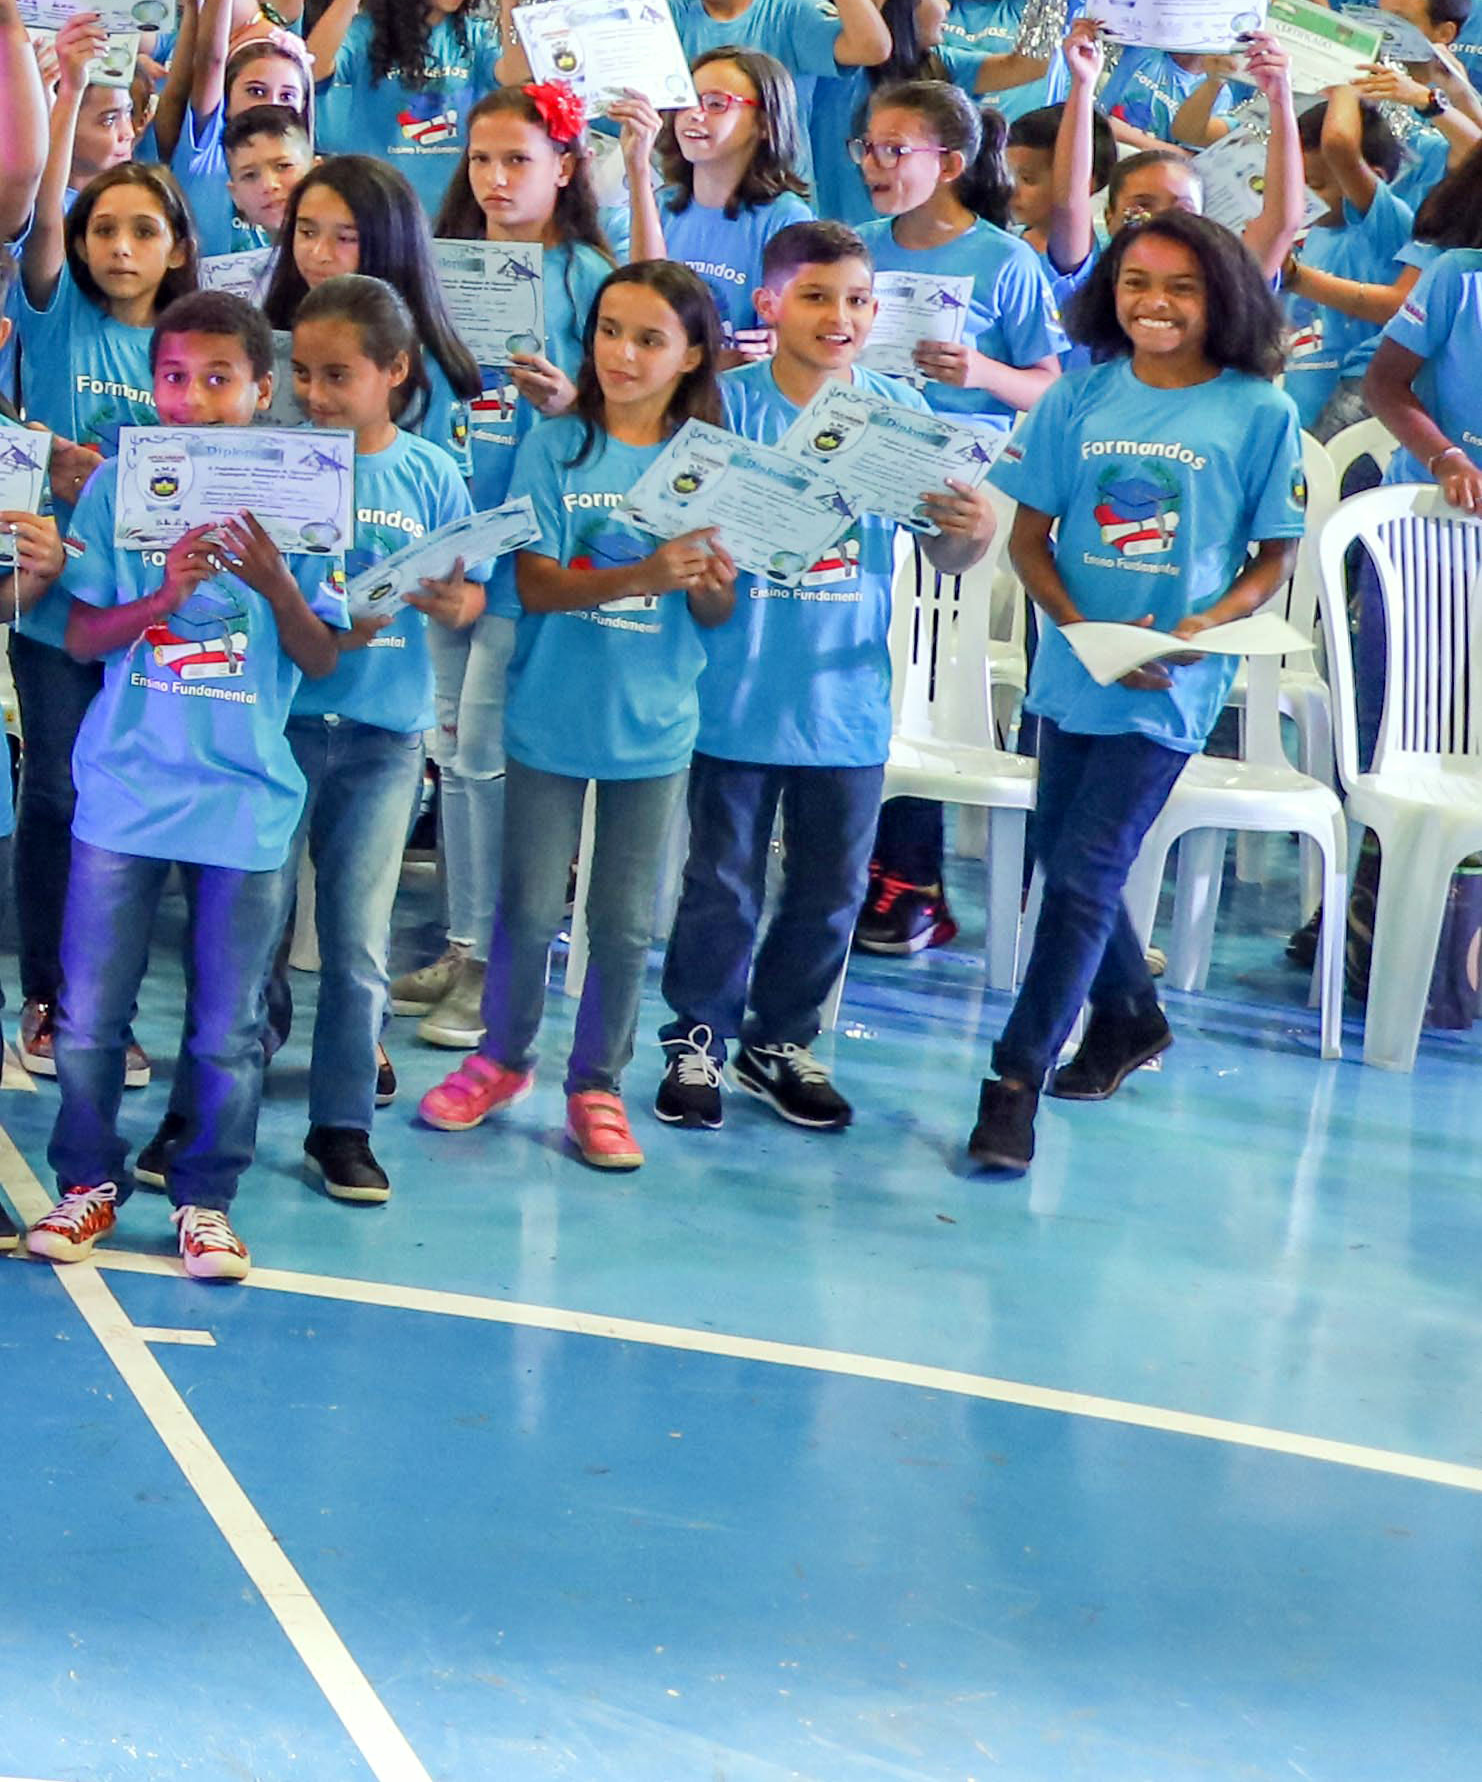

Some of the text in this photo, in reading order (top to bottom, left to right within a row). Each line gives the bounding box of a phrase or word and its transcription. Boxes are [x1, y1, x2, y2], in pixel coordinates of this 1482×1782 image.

[1082, 440, 1207, 471] Formandos
[750, 587, 790, 599] Ensino
[131, 672, 257, 705] Ensino Fundamental
